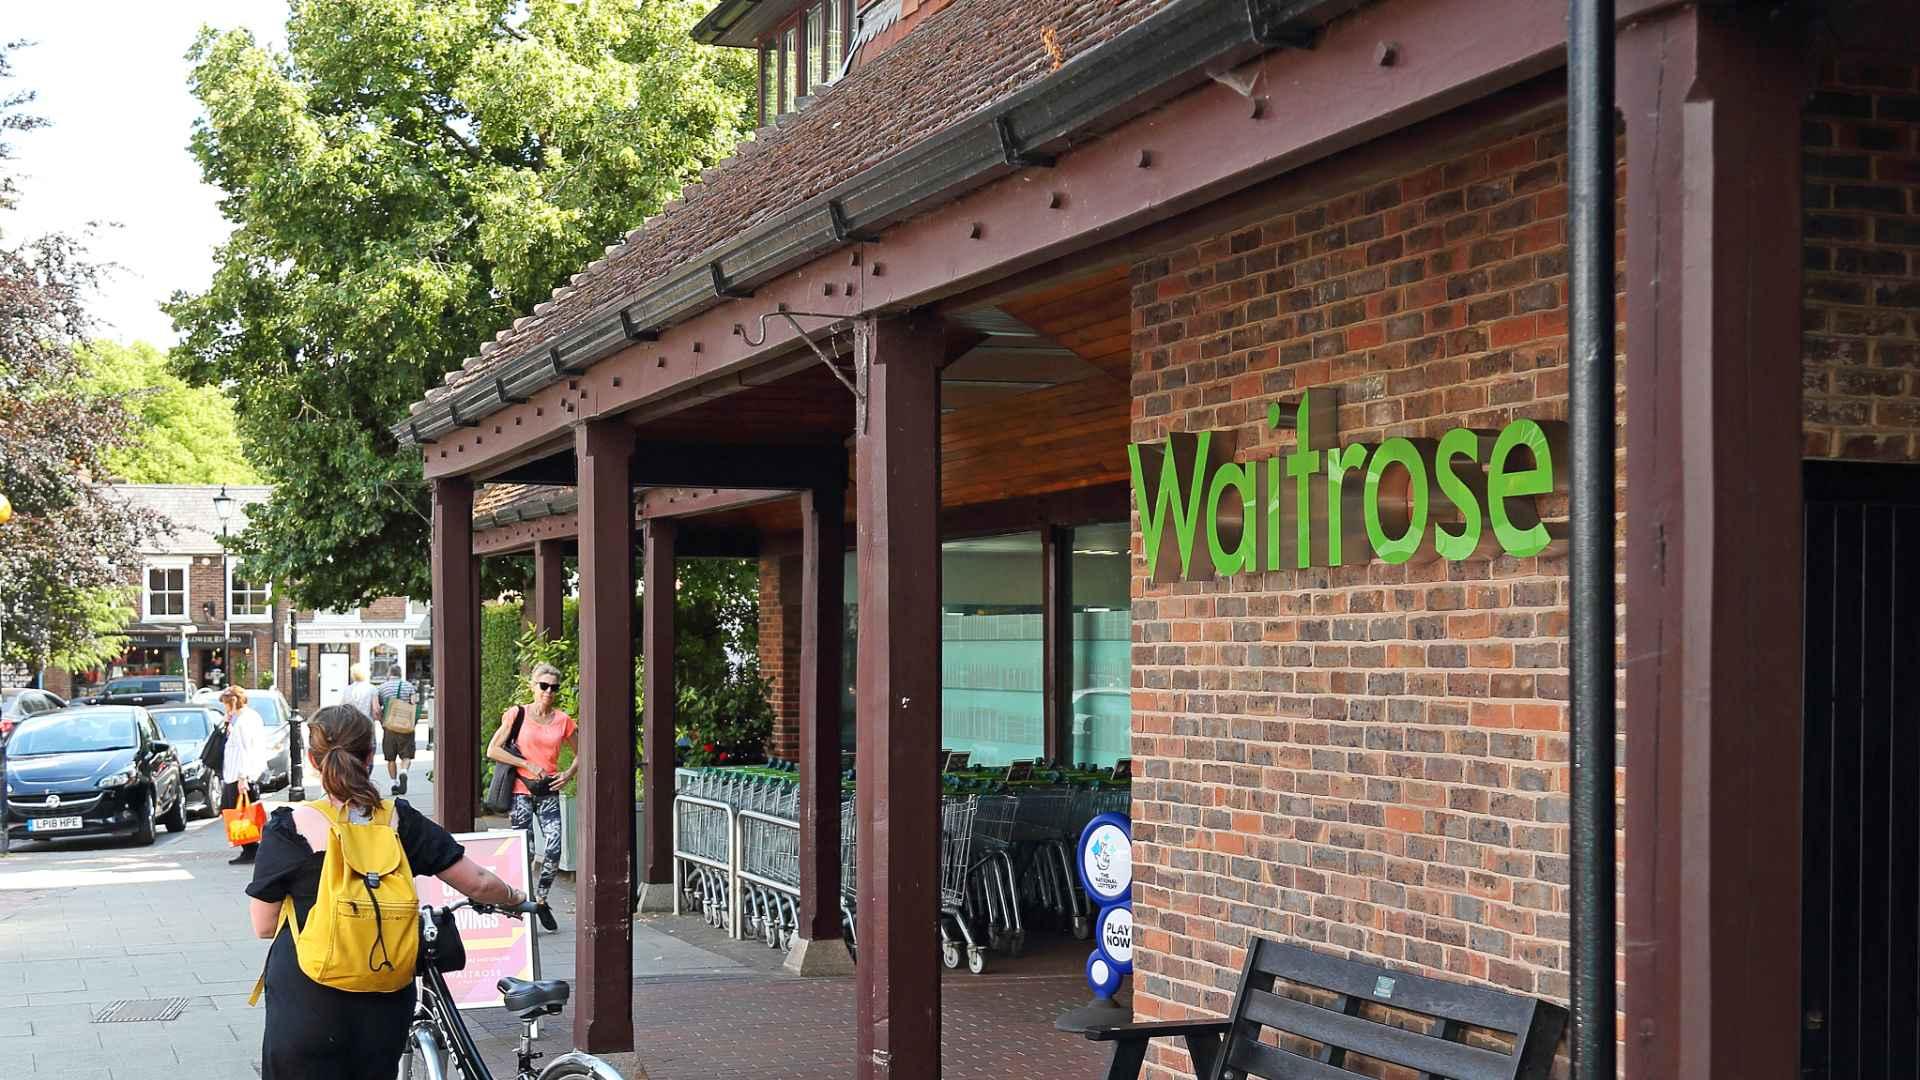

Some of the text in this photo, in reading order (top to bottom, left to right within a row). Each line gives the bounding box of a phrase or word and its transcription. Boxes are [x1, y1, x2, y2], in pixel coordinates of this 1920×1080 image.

[1128, 387, 1554, 581] Waitrose
[354, 629, 401, 639] MANOR
[60, 817, 80, 827] HPE
[1106, 922, 1130, 936] PLAY
[1106, 935, 1131, 949] NOW
